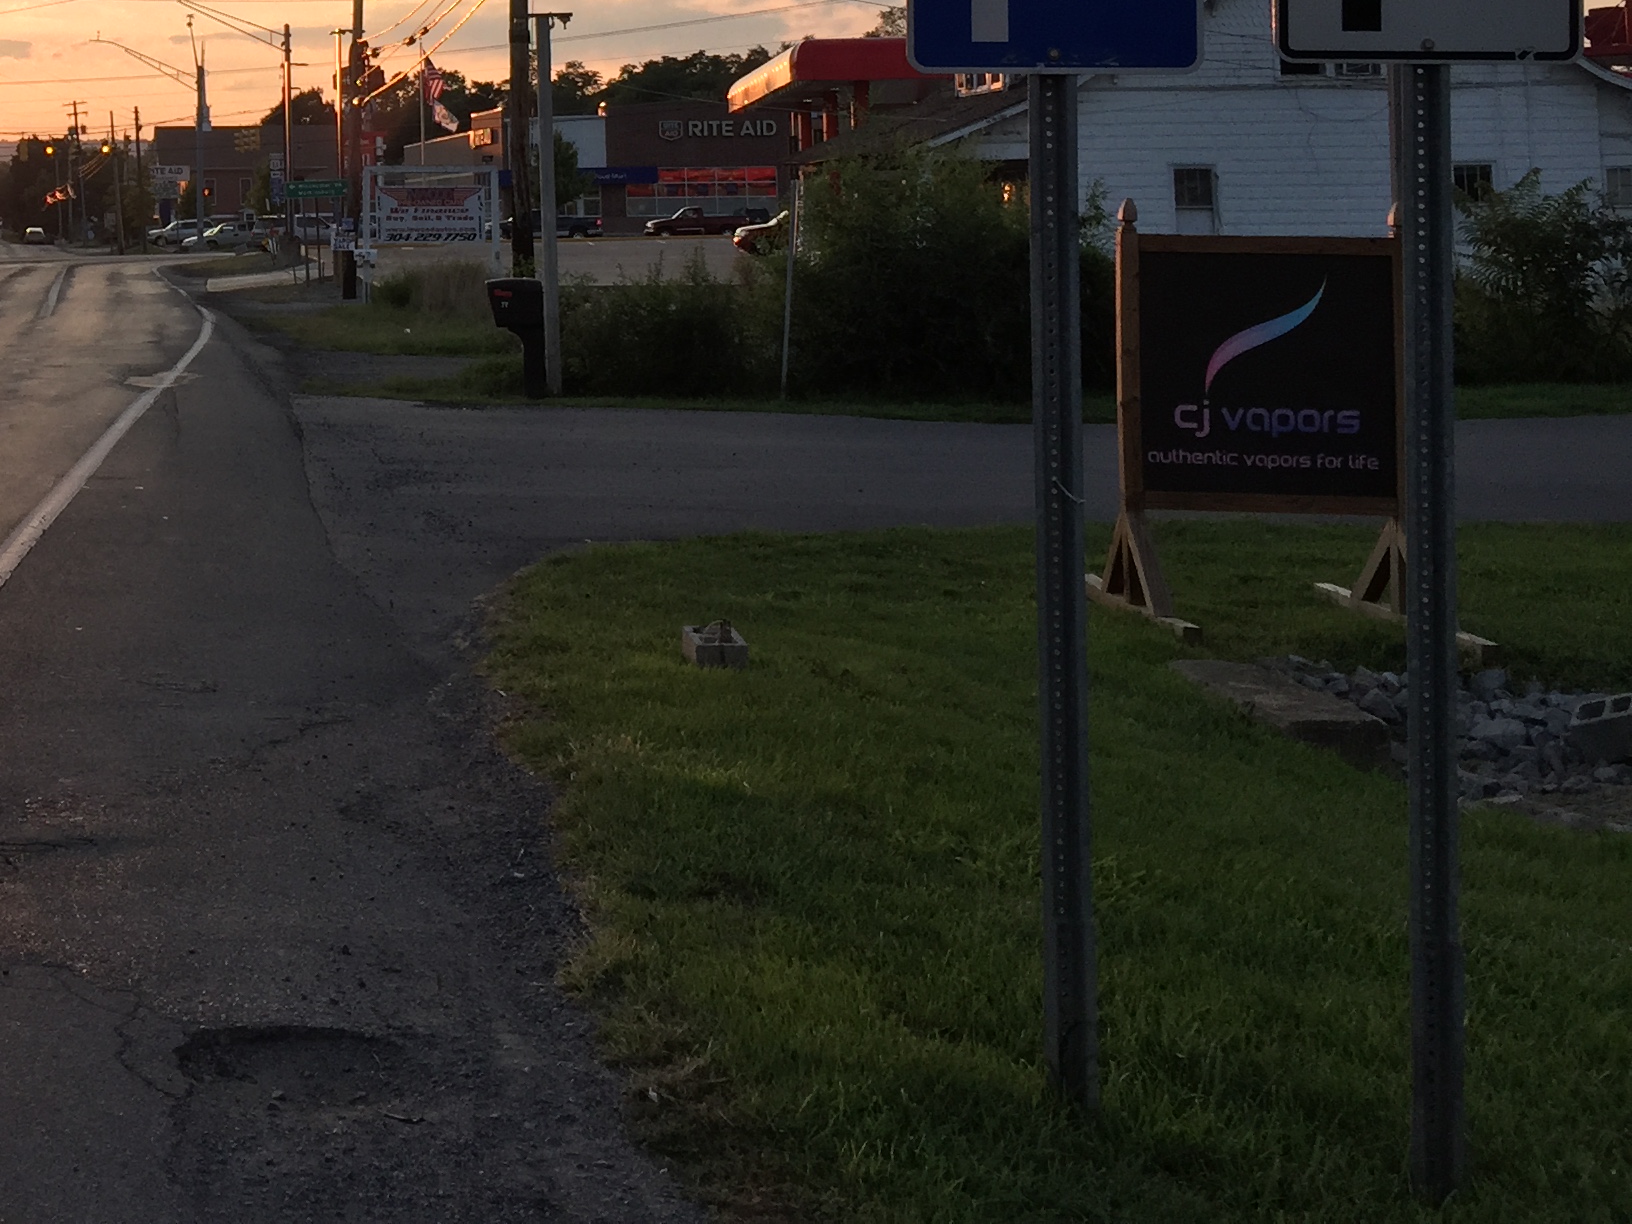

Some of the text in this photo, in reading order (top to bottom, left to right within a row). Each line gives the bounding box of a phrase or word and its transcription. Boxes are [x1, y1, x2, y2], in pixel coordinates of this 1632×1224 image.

[688, 120, 777, 137] RITE AID
[1173, 399, 1361, 438] cj vapors
[1147, 449, 1380, 471] authentic vapors for life
